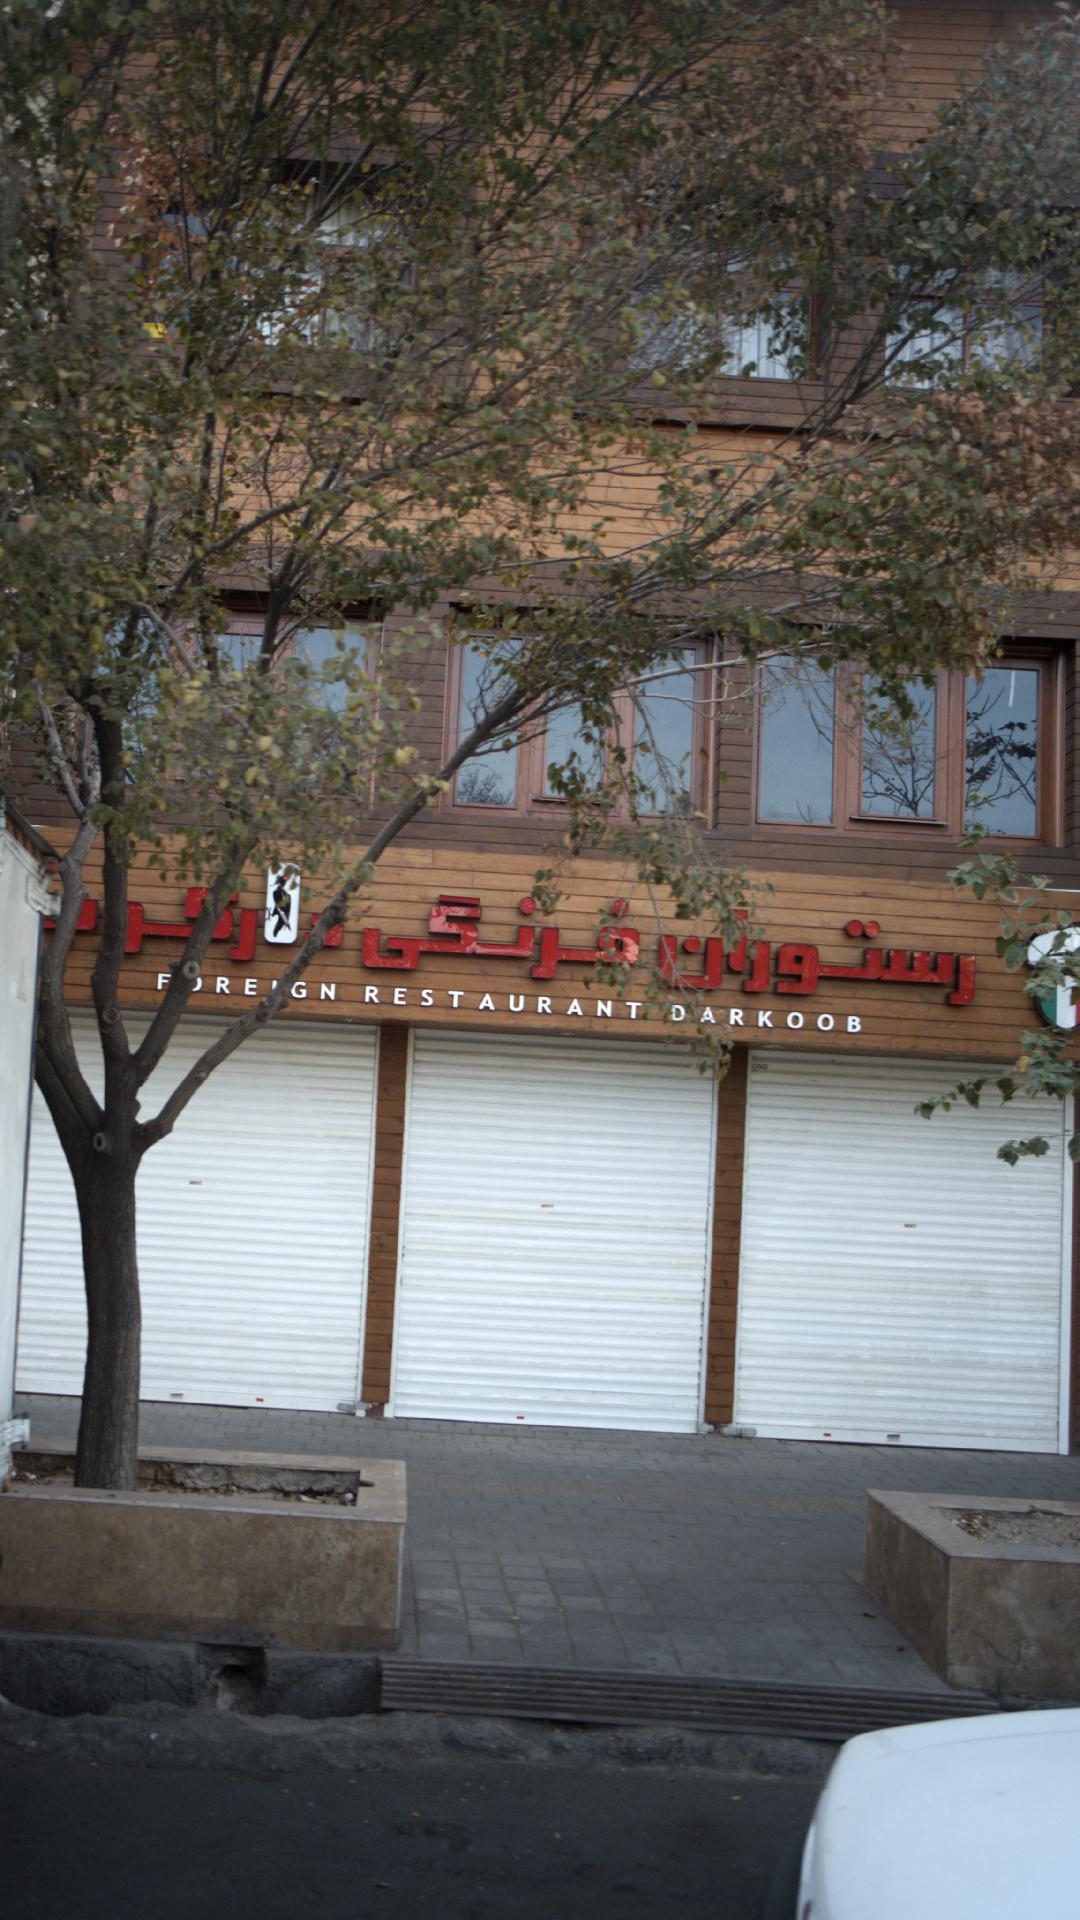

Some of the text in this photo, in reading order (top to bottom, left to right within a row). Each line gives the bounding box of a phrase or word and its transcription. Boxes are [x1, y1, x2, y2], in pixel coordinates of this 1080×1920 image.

[361, 894, 641, 979] فرنگی
[659, 908, 977, 1005] رستوران
[363, 985, 642, 1019] RESTAURANT
[671, 1004, 862, 1033] DARKOOB
